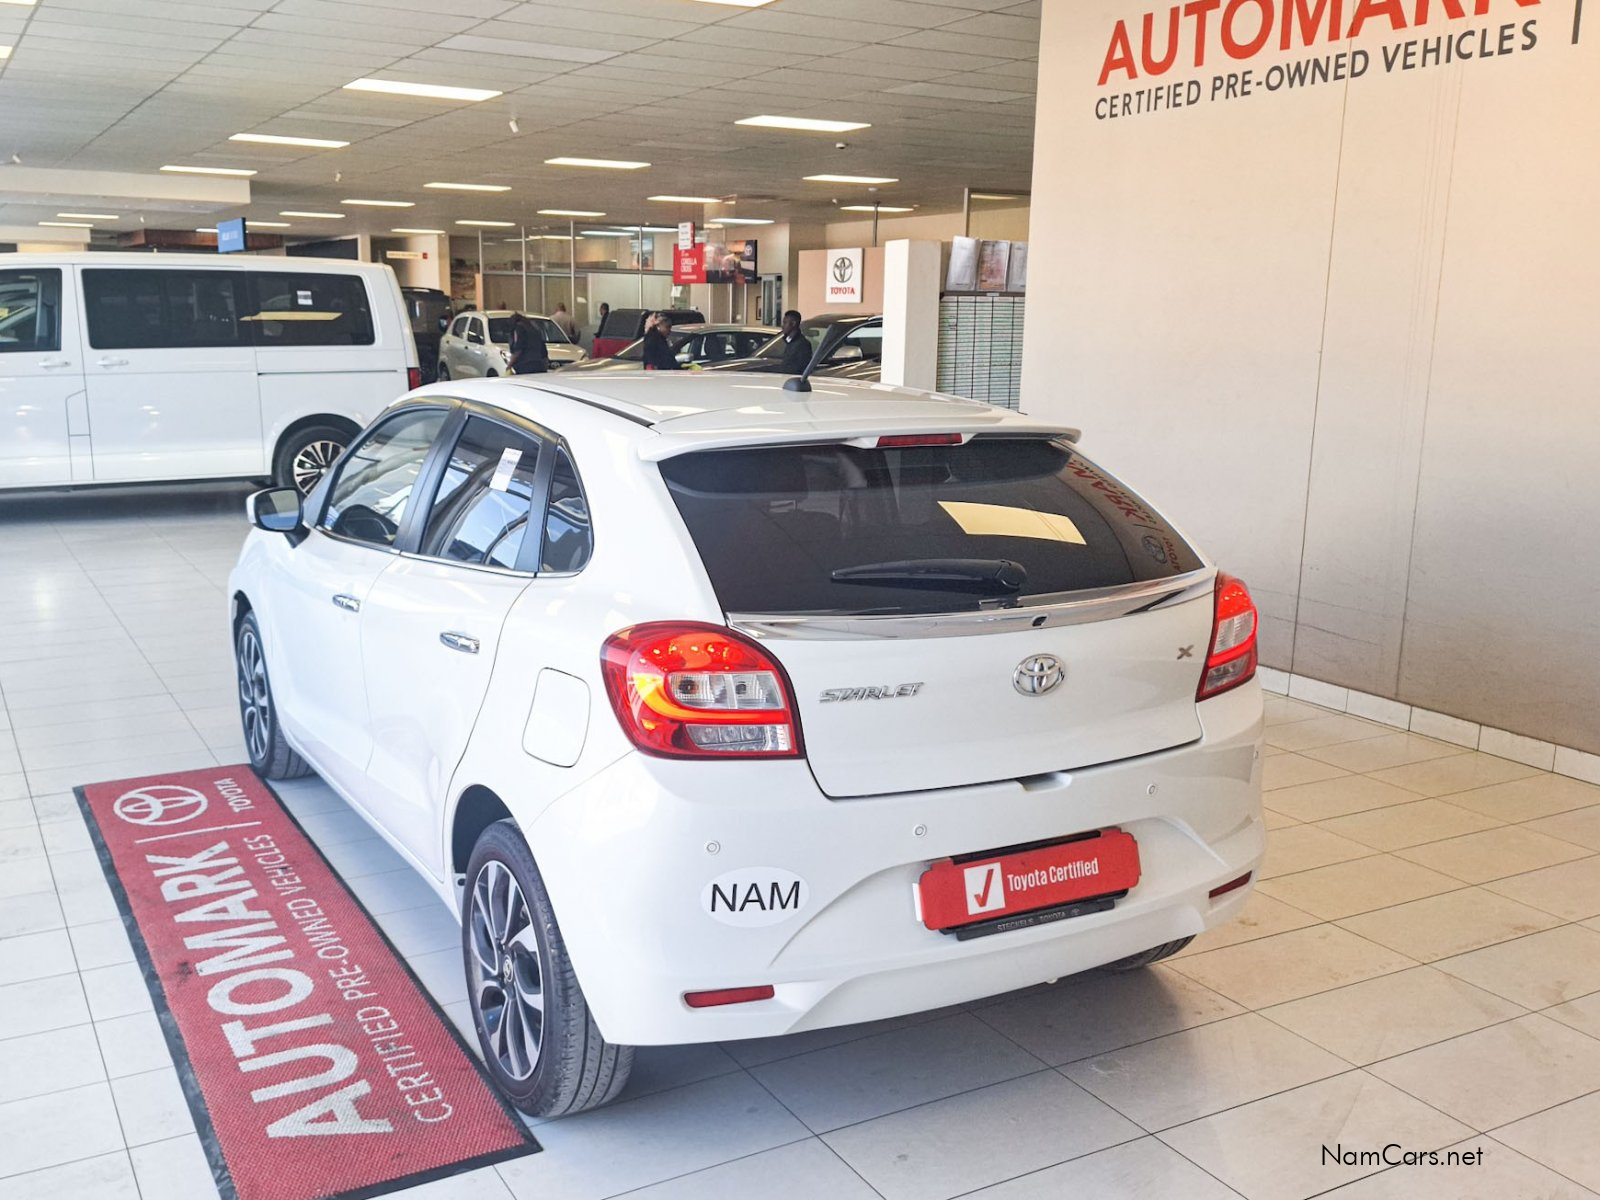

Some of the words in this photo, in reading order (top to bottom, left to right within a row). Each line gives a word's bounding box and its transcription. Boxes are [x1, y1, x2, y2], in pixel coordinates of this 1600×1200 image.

[1095, 80, 1201, 120] CERTIFIED
[1211, 49, 1370, 102] PRE-OWNED
[1382, 19, 1538, 73] VEHICLES
[830, 286, 856, 295] TOYOTA
[1177, 645, 1194, 660] X
[819, 682, 924, 704] STARLET
[214, 777, 255, 813] TOYOTA
[243, 834, 308, 896] VEHICLES
[1007, 869, 1047, 891] Toyota
[1049, 858, 1099, 884] Certified
[711, 881, 800, 912] NAM
[1039, 911, 1066, 922] TOYOTA
[285, 898, 378, 1001] PRE-OWNED
[145, 841, 394, 1138] AUTOMARK
[355, 1005, 453, 1123] CERTIFIED
